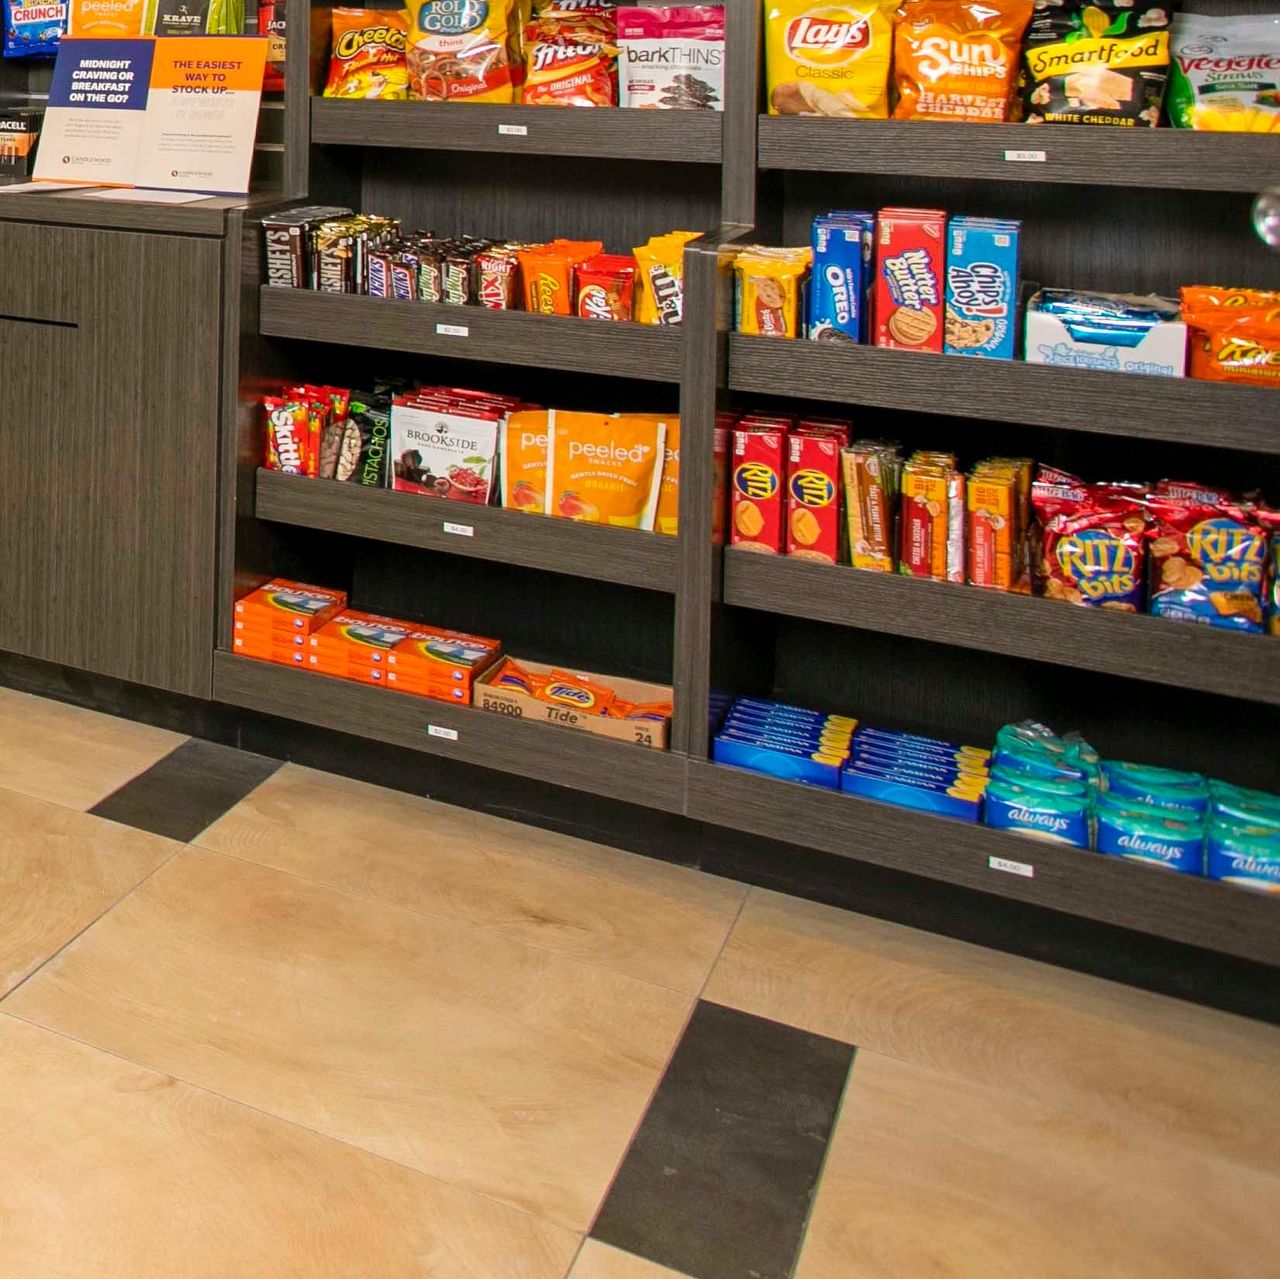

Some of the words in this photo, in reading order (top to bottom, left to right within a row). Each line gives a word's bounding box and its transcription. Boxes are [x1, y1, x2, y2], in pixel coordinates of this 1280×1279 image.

[13, 7, 64, 21] CRUNCH
[431, 0, 480, 14] ROLD
[163, 14, 201, 23] KRAVE
[424, 13, 481, 30] GOLD
[79, 59, 131, 69] MIDNIGHT
[627, 45, 722, 66] barkTHINS
[1034, 40, 1160, 73] Smartfood
[173, 60, 194, 69] THE
[195, 60, 242, 70] EASIEST
[795, 65, 854, 81] Classic
[72, 70, 118, 80] CRAVING
[119, 71, 134, 81] OR
[185, 73, 207, 82] WAY
[211, 73, 226, 82] TO
[550, 74, 594, 91] ORIGINAL
[1204, 71, 1264, 83] Straws
[72, 82, 131, 92] BREAKFAST
[172, 85, 209, 94] STOCK
[451, 80, 488, 95] Original
[69, 93, 85, 102] ON
[86, 93, 108, 102] THE
[109, 93, 129, 103] GO?
[919, 92, 1007, 108] HARVEST
[916, 103, 1004, 119] CHEDDAR
[1044, 112, 1080, 123] WHITE
[1083, 114, 1135, 127] CHEDDAR
[266, 230, 290, 288] RSHEY'S
[481, 261, 513, 273] RIGHT
[886, 258, 922, 312] Butter
[904, 250, 939, 305] Nutter
[970, 263, 1004, 307] Chips
[826, 265, 849, 324] OREO
[983, 320, 1007, 351] ORIGINAL
[1125, 361, 1173, 375] Original
[407, 429, 478, 451] BROOKSIDE
[569, 440, 644, 463] peeled
[588, 458, 623, 467] SNACKS
[585, 480, 625, 492] ORGANIC
[741, 464, 772, 499] RITZ
[798, 470, 829, 506] RITZ
[1187, 523, 1265, 562] RITZ
[1057, 536, 1134, 576] RITZ
[1205, 562, 1262, 582] bits
[1079, 575, 1135, 598] bits
[550, 684, 590, 704] Tide
[482, 698, 522, 717] 84900
[546, 706, 578, 724] Tide
[635, 732, 652, 745] 24
[1008, 808, 1069, 832] always
[1117, 832, 1184, 859] always
